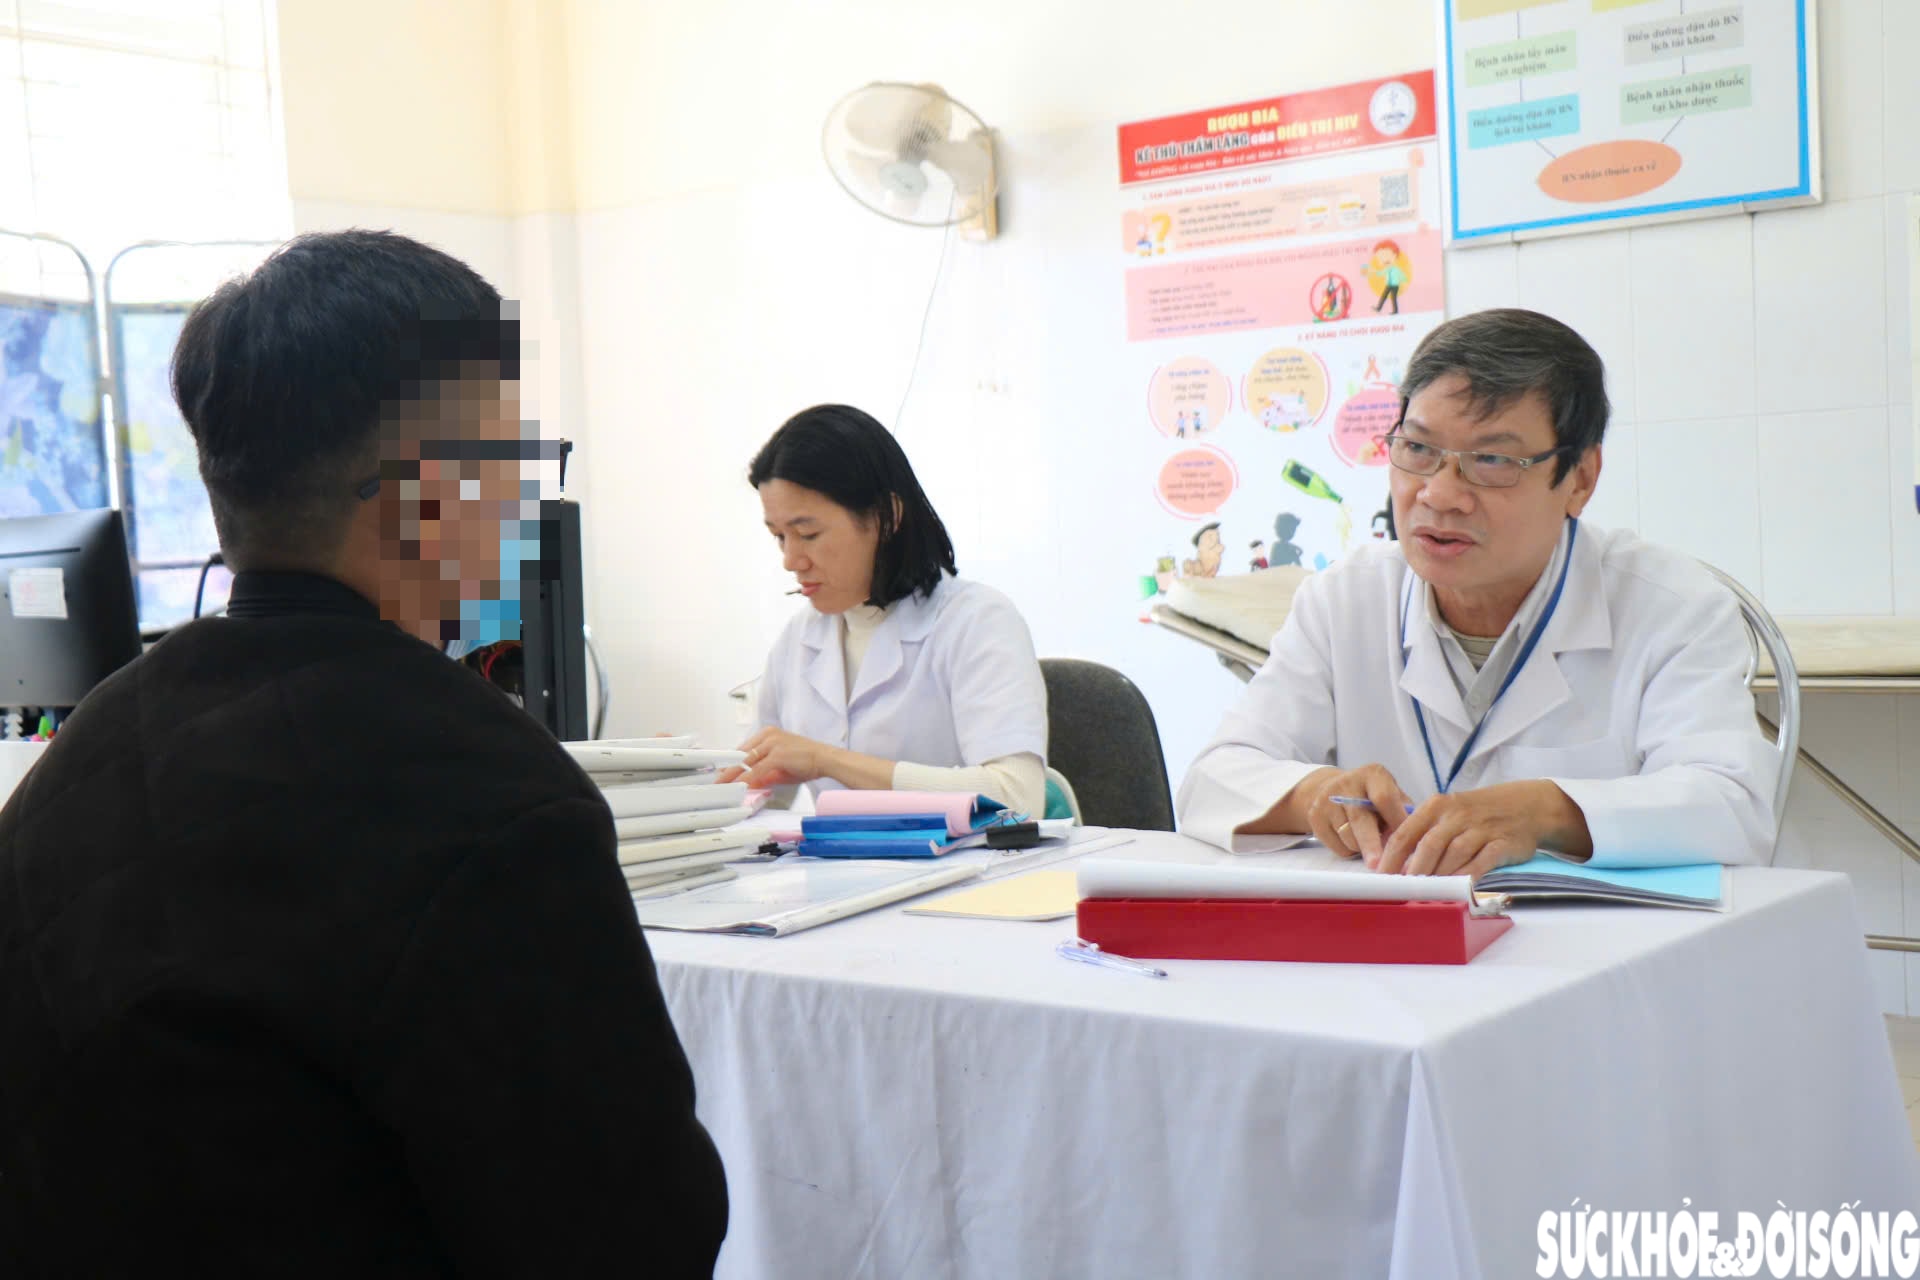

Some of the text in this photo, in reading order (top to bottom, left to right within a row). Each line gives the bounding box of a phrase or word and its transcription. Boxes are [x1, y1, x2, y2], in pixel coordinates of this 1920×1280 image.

[1626, 91, 1653, 104] Bệnh
[1715, 75, 1744, 89] thuốc
[1207, 107, 1279, 133] RƯỢU BIA
[1334, 114, 1359, 130] HIV
